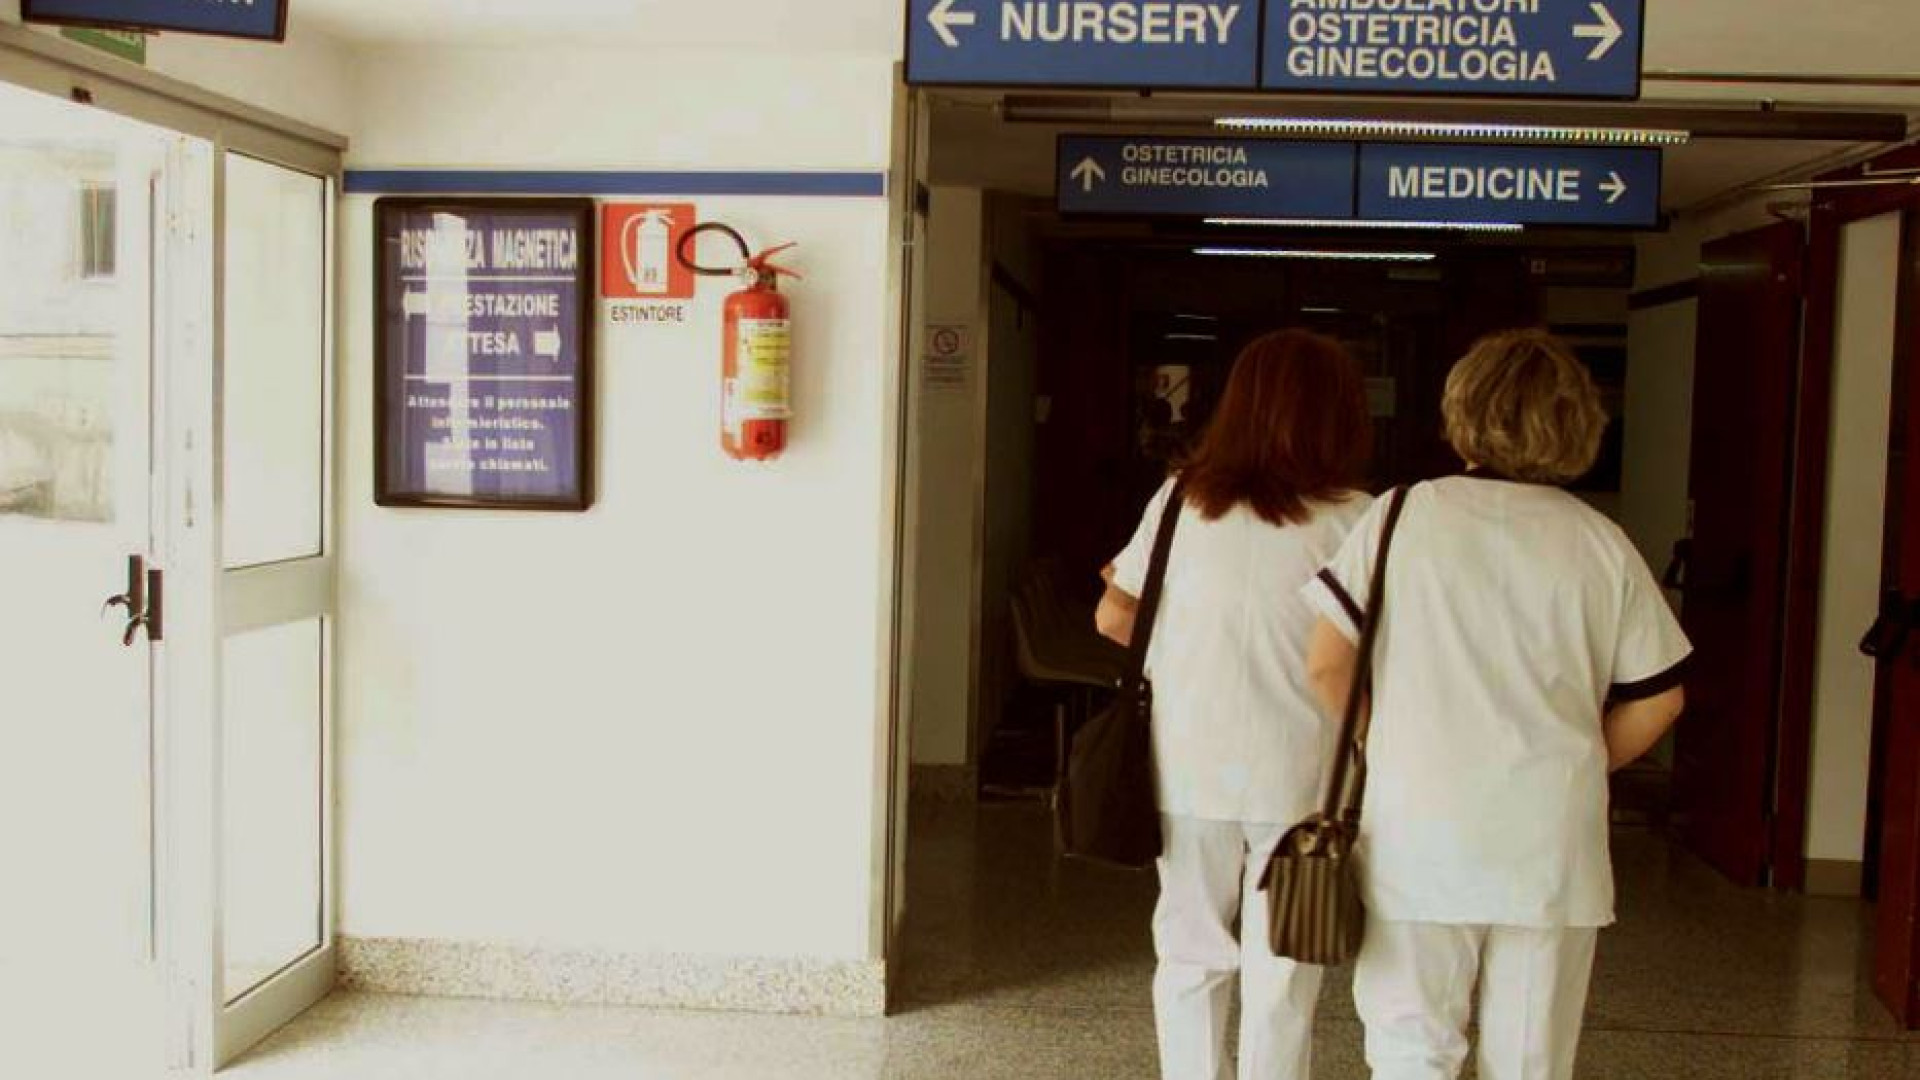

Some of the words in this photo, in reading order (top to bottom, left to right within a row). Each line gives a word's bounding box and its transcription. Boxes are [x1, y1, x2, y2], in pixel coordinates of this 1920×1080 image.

[1001, 1, 1240, 44] NURSERY
[1288, 12, 1517, 46] OSTETRICIA
[1287, 46, 1555, 81] GINECOLOGIA
[1122, 145, 1248, 164] OSTETRICIA
[1122, 167, 1269, 188] GINECOLOGIA
[1388, 166, 1581, 201] MEDICINE
[493, 228, 577, 270] MAGNETICA
[610, 305, 684, 323] ESTINTORE
